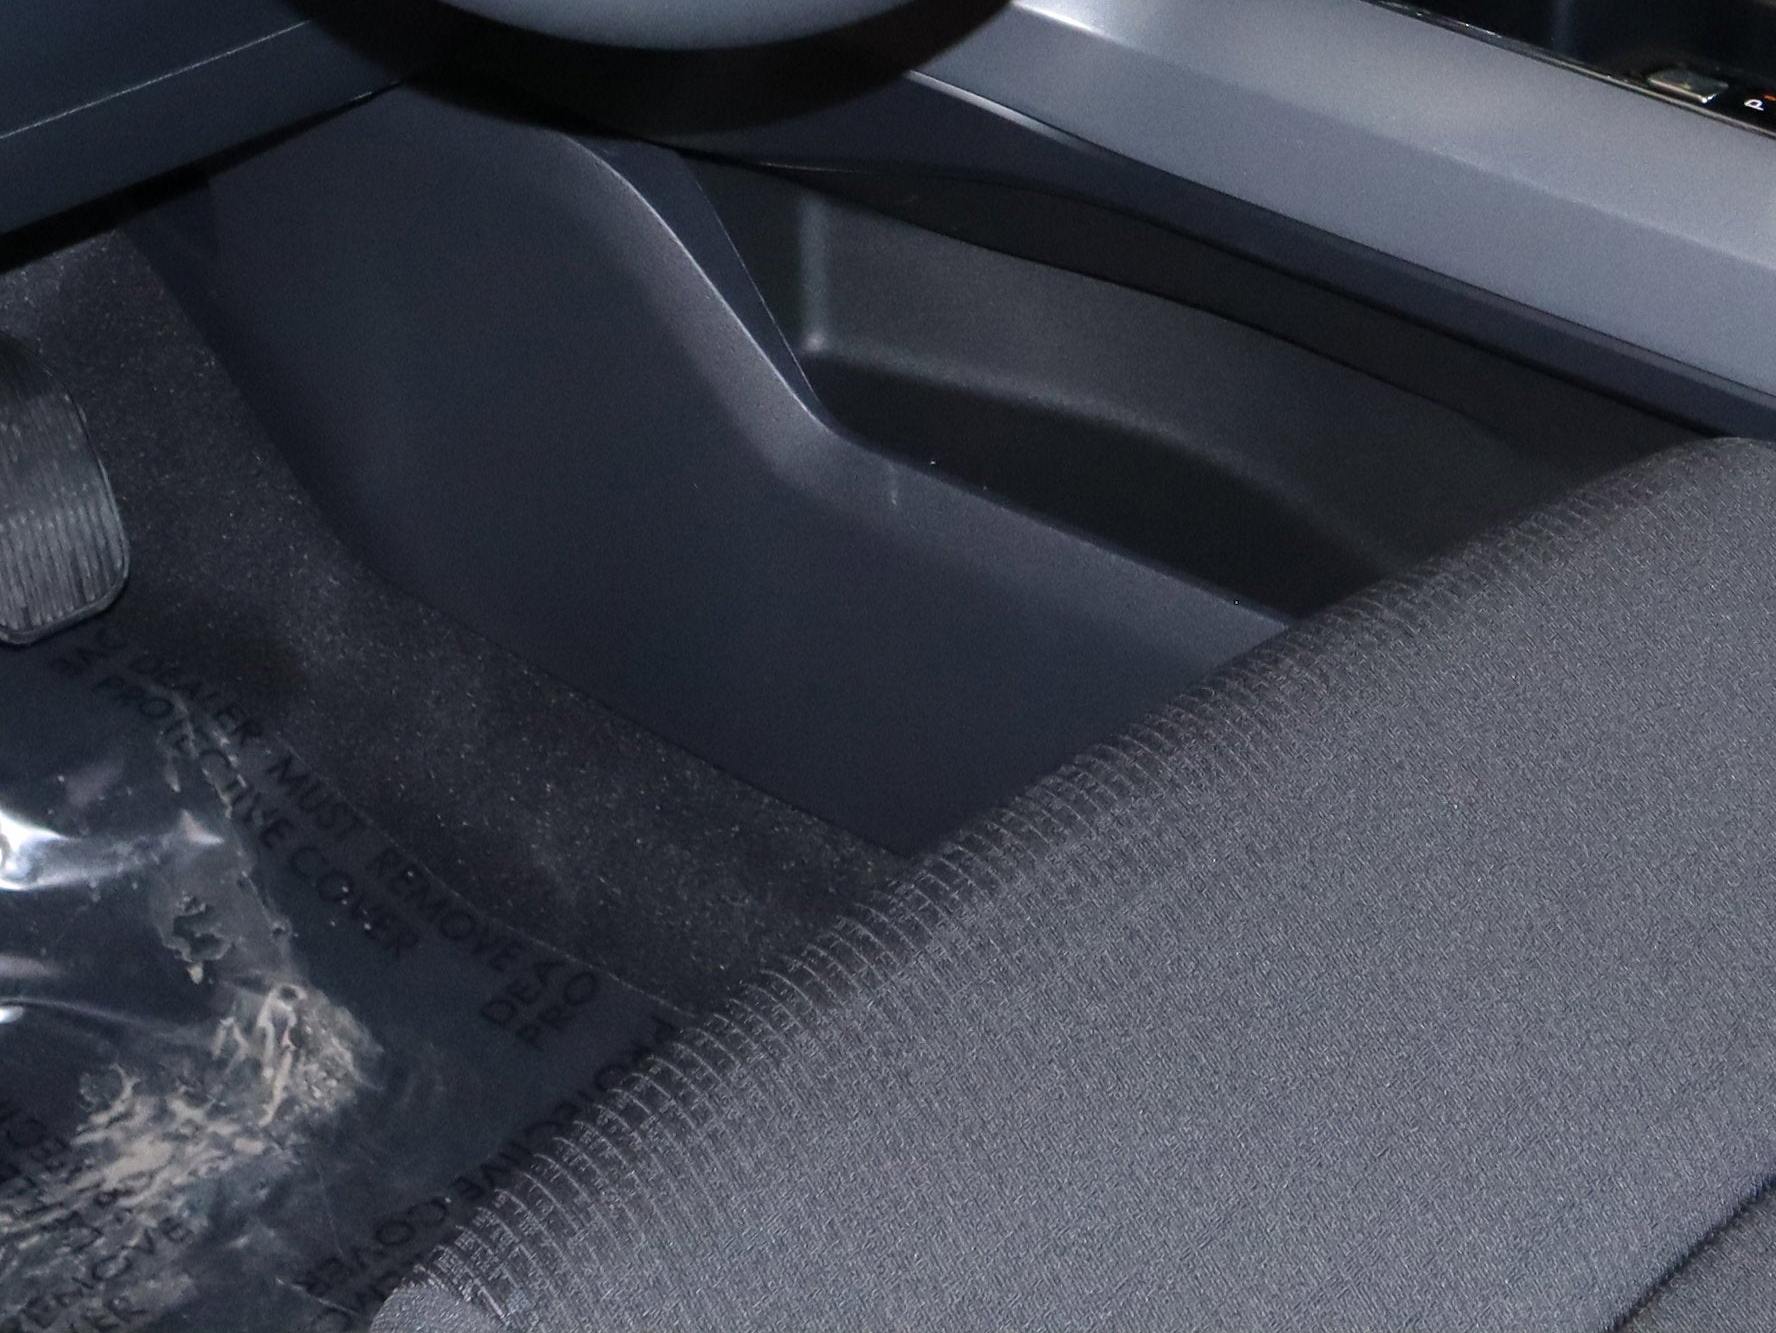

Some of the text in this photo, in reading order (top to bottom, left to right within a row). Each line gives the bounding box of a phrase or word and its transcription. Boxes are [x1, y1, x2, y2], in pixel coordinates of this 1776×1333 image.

[1744, 98, 1765, 111] P
[265, 756, 366, 840] MUST
[365, 847, 525, 972] REMOVE
[288, 845, 420, 960] COVER
